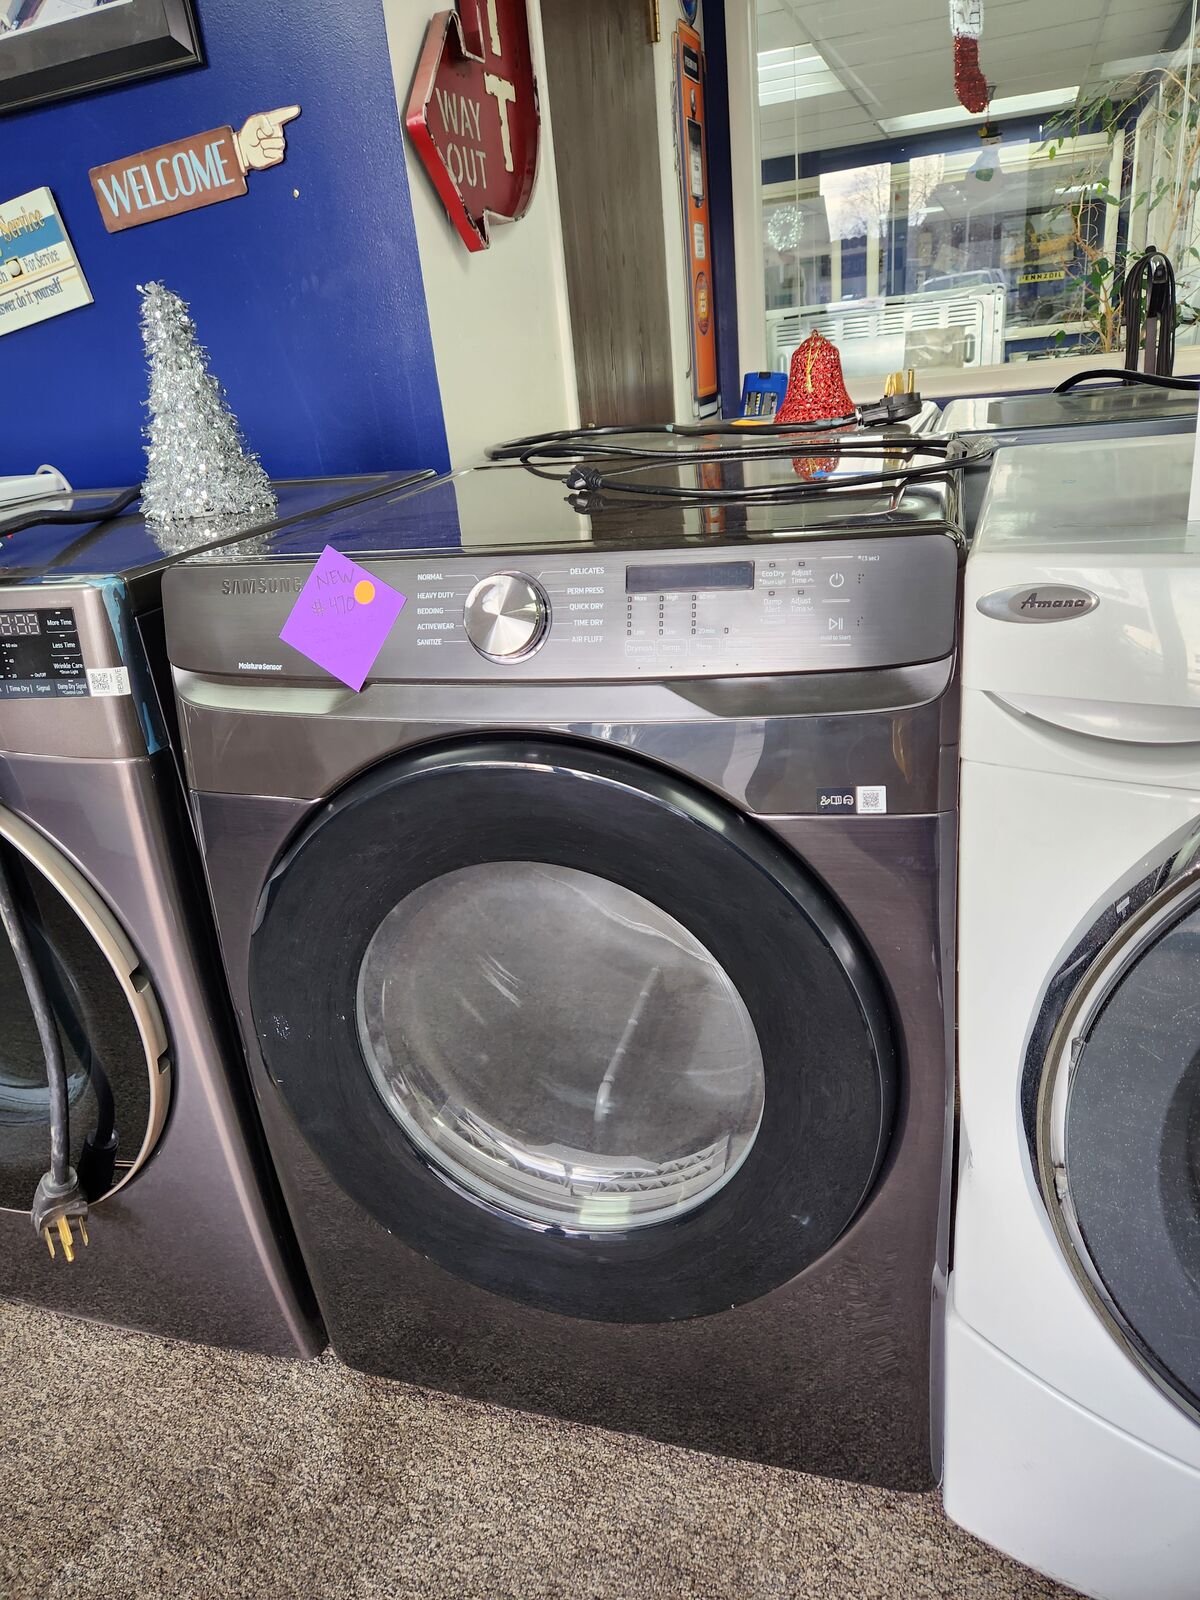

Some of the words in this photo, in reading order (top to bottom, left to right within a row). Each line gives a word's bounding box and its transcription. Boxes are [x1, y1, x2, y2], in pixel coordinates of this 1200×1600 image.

[435, 88, 482, 141] WAY
[446, 142, 487, 189] OUT
[97, 140, 235, 217] WELCOME
[23, 257, 37, 273] For
[34, 248, 60, 268] Service
[15, 292, 27, 309] do
[24, 289, 34, 305] it
[32, 276, 64, 306] yourself
[316, 568, 355, 590] NEW
[569, 567, 605, 575] DELICATES
[222, 577, 302, 595] SAMSUNG
[437, 591, 455, 599] DUTY
[567, 587, 584, 595] PERM
[569, 603, 589, 611] QUICK
[1021, 592, 1086, 610] Amana
[238, 662, 262, 670] Moisture
[262, 663, 283, 671] Sensor
[21, 685, 30, 693] Dry
[68, 683, 76, 691] Dry
[114, 668, 124, 694] REMOVE
